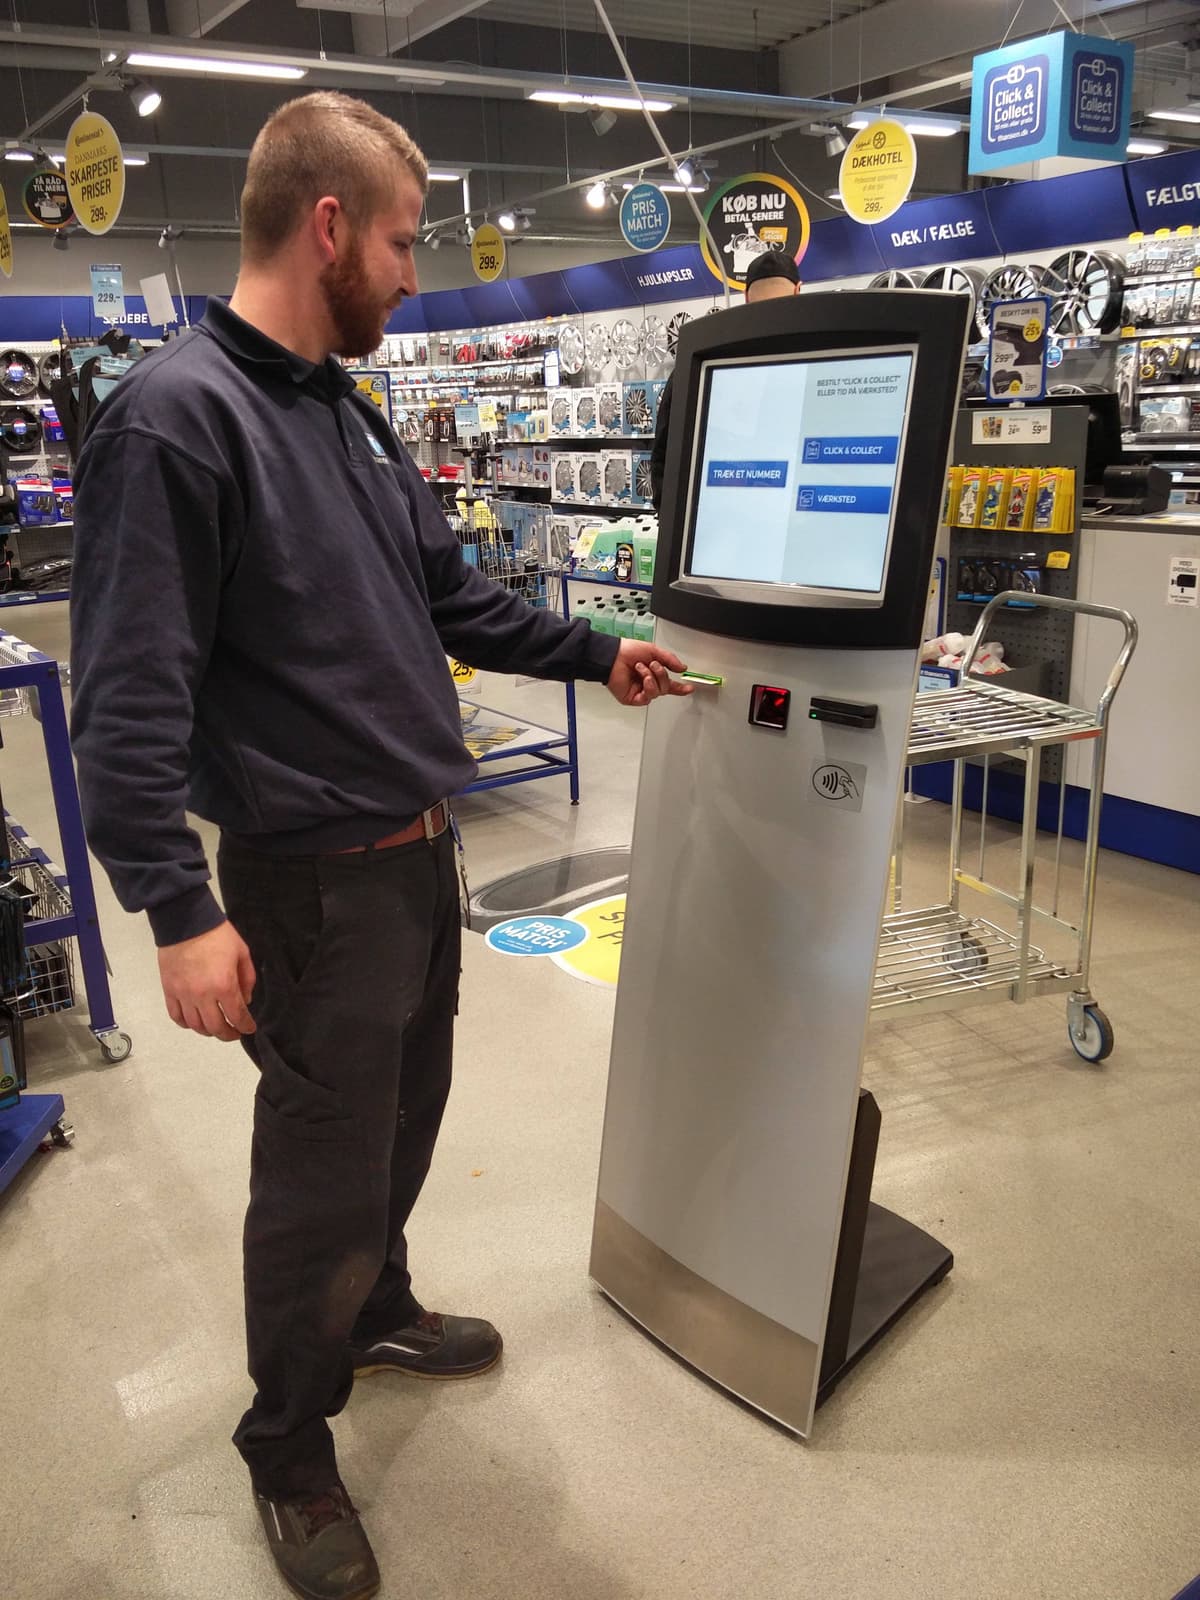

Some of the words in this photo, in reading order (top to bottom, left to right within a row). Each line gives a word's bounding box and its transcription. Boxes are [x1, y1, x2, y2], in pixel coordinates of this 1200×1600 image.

[995, 87, 1021, 107] Click
[1024, 84, 1034, 99] &
[1082, 79, 1103, 96] Click
[1104, 83, 1112, 97] &
[994, 102, 1034, 123] Collect
[1081, 96, 1112, 114] Collect
[74, 146, 108, 164] DANMARKS
[852, 152, 903, 169] DÆKHOTEL
[70, 156, 119, 187] SKARPESTE
[34, 184, 45, 192] TIL
[45, 184, 66, 192] MERE
[35, 177, 45, 185] FÅ
[45, 177, 62, 185] RÅD
[81, 179, 112, 202] PRISER
[632, 199, 656, 217] PRIS
[722, 195, 759, 214] KØB
[760, 193, 787, 209] NU
[863, 202, 883, 214] 299,-
[90, 206, 108, 224] 299,-
[724, 213, 751, 224] BETAL
[751, 210, 784, 222] SENERE
[891, 228, 922, 248] DÆK
[923, 229, 928, 243] /
[929, 220, 976, 241] FÆLGE
[479, 256, 500, 271] 299,-
[637, 268, 695, 288] HJULKAPSLER
[97, 293, 121, 303] 229,-
[817, 378, 841, 387] BESTILT
[863, 377, 869, 385] &
[817, 388, 836, 397] ELLER
[836, 388, 847, 396] TID
[848, 386, 857, 396] PÅ
[858, 386, 898, 395] VÆRKSTED?
[823, 446, 843, 455] CLICK
[844, 447, 850, 455] &
[850, 446, 883, 455] COLLECT
[713, 470, 735, 479] TRÆK
[736, 470, 744, 479] ET
[746, 469, 781, 480] NUMMER
[818, 495, 856, 504] VÆRKSTED
[525, 921, 571, 939] PRIS
